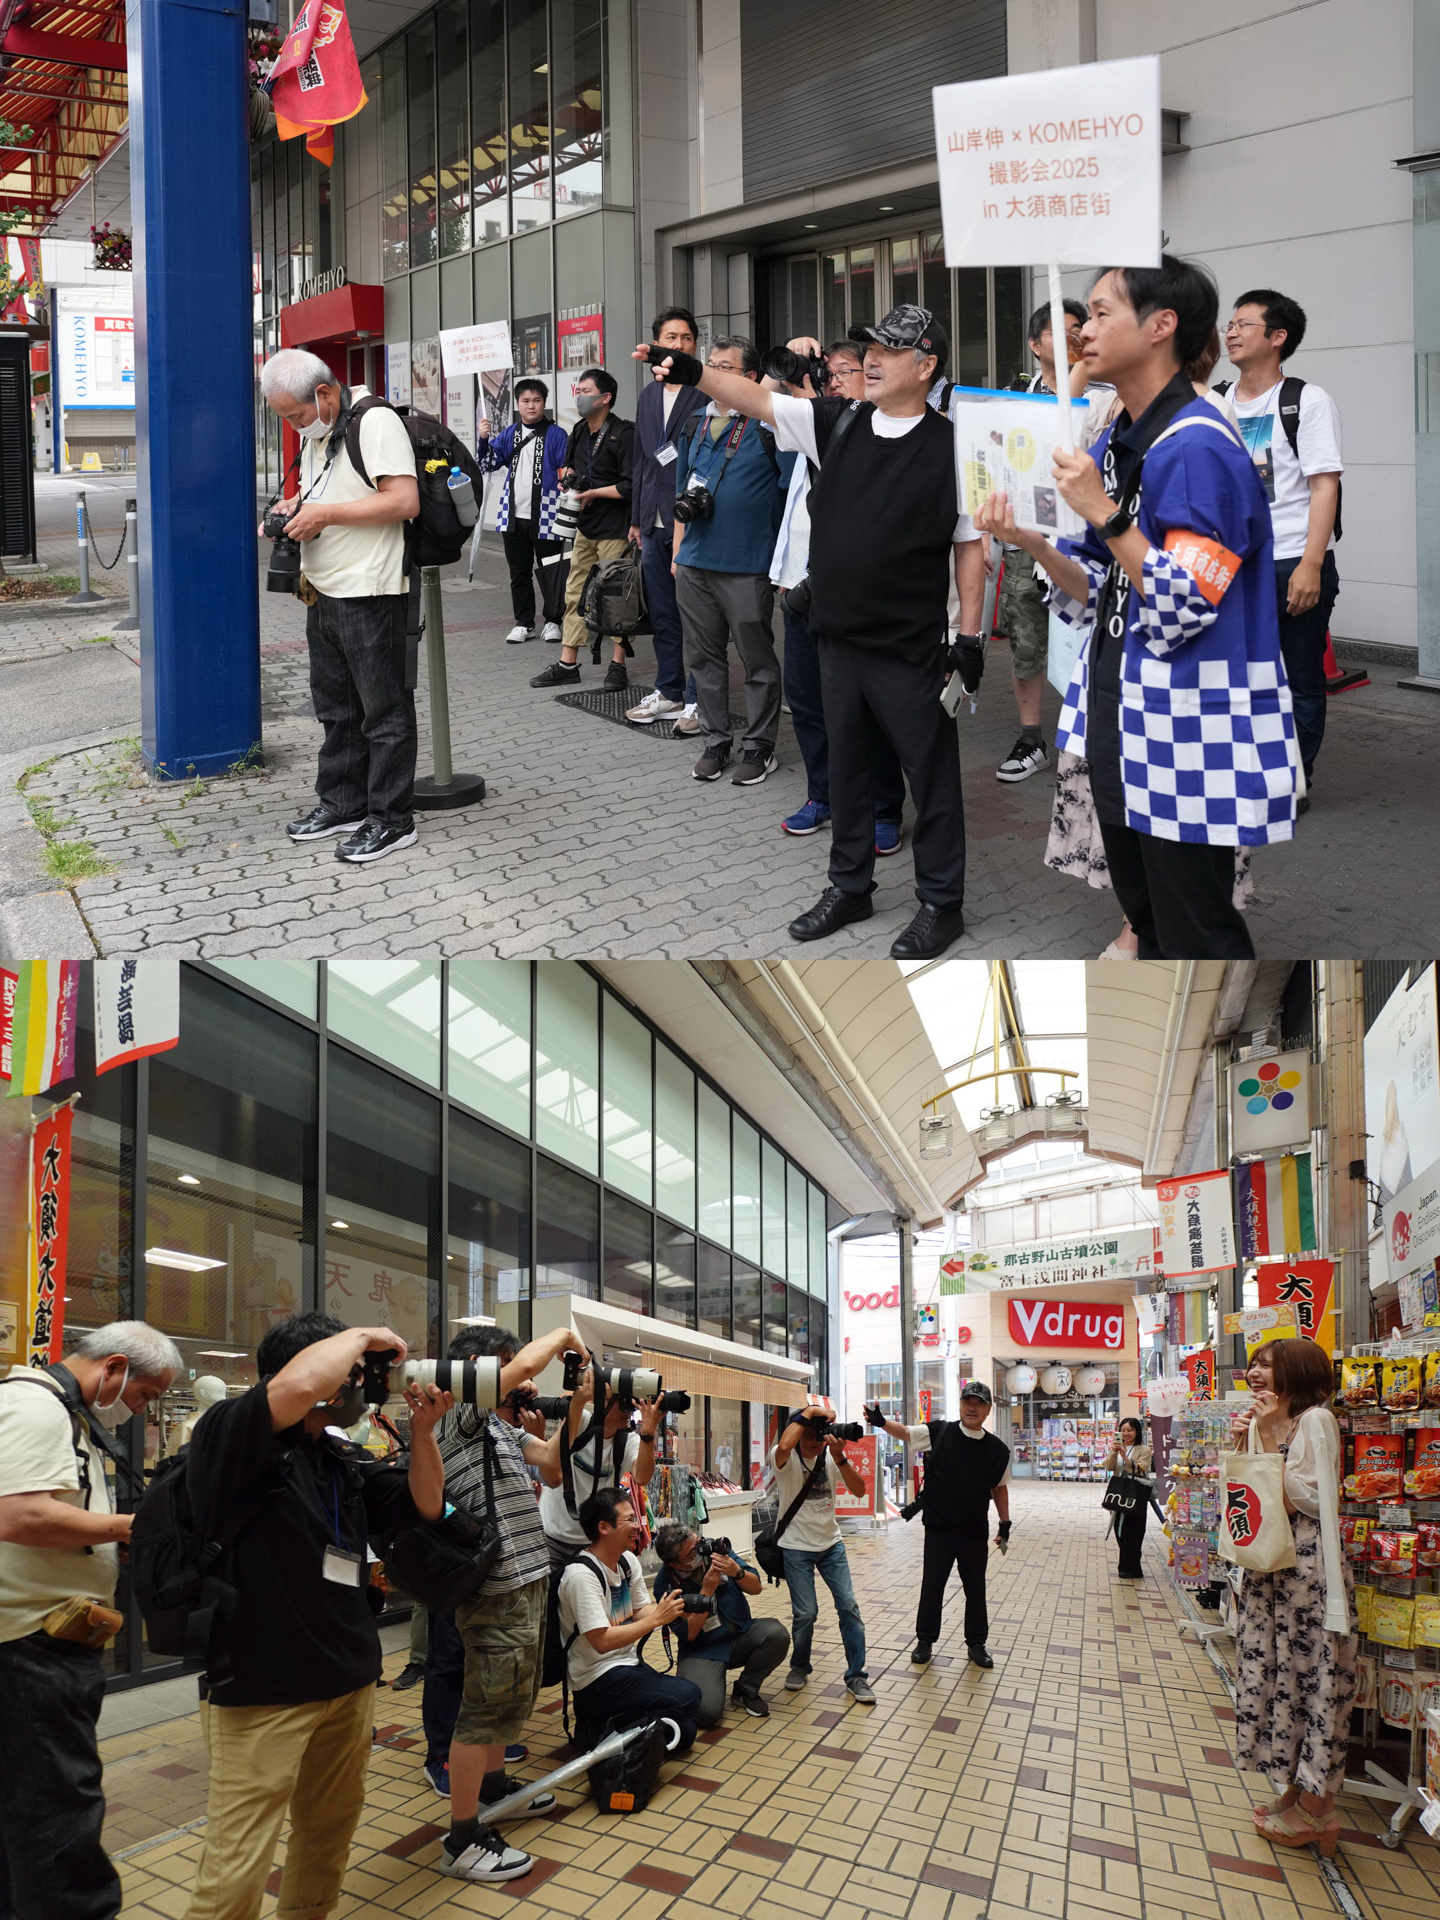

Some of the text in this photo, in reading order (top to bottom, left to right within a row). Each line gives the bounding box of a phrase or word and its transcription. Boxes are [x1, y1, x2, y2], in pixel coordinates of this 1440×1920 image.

[948, 126, 1004, 153] 山岸伸
[1029, 113, 1143, 144] KOMEHYO
[988, 157, 1099, 185] 撮影会2025
[983, 192, 1111, 219] in 大須商店街
[298, 266, 345, 302] KOMEHYO
[74, 316, 87, 398] KOMEHYO
[534, 436, 545, 485] KOMEHYO
[1418, 1189, 1439, 1210] Japan.
[1246, 1188, 1262, 1255] 大須観音通
[1417, 1206, 1440, 1229] Endless
[1004, 1240, 1118, 1267] 那古野山古墳公園
[999, 1265, 1108, 1288] 富士浅間神社
